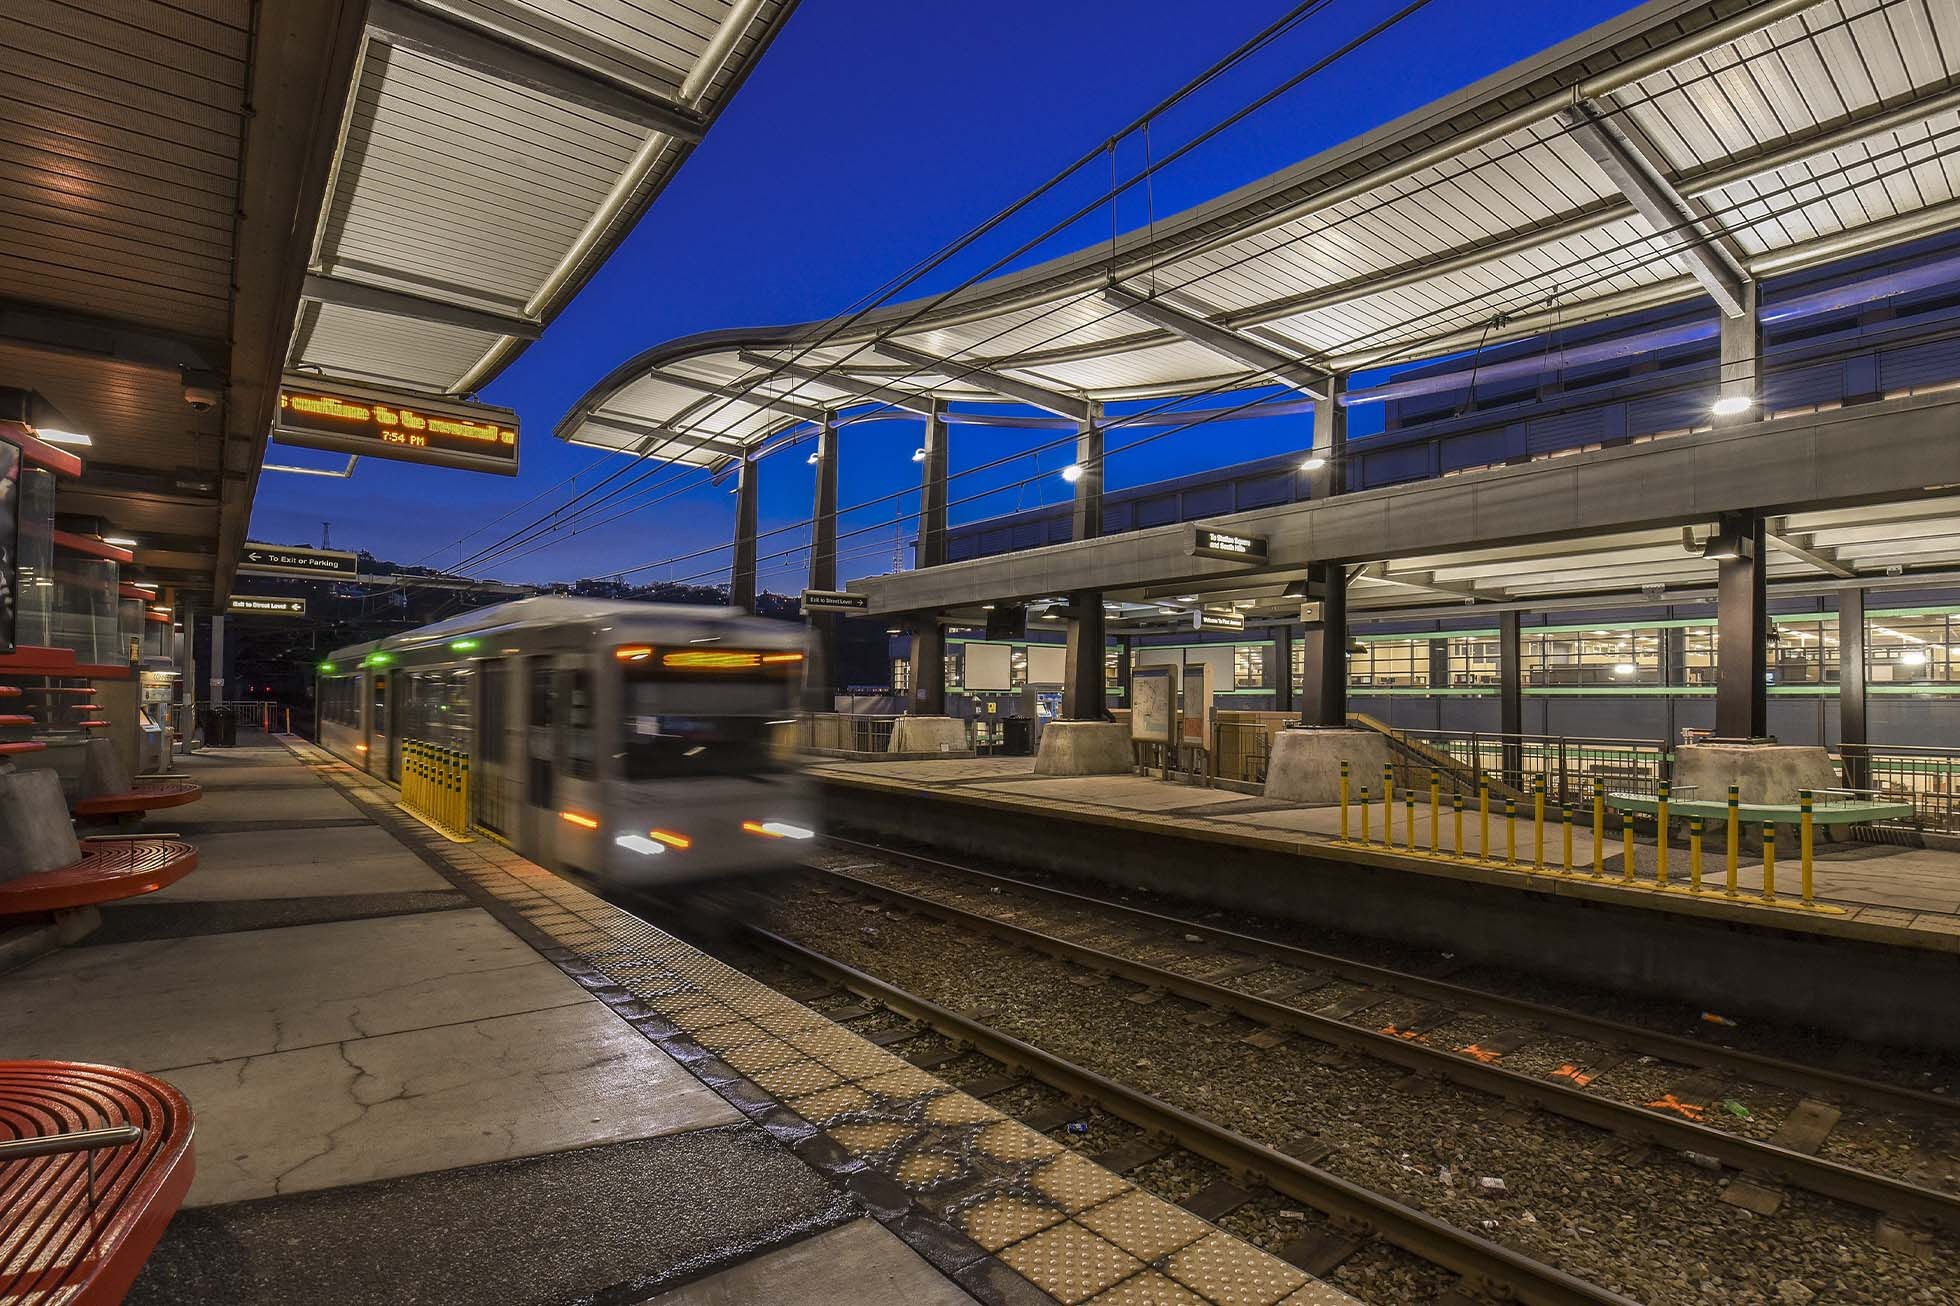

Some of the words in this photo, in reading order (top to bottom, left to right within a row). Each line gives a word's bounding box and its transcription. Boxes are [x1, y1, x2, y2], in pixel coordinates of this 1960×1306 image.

[382, 431, 405, 443] 7:54
[410, 435, 425, 446] PM
[268, 554, 279, 562] To
[280, 555, 296, 564] Exit
[309, 558, 339, 568] Parking
